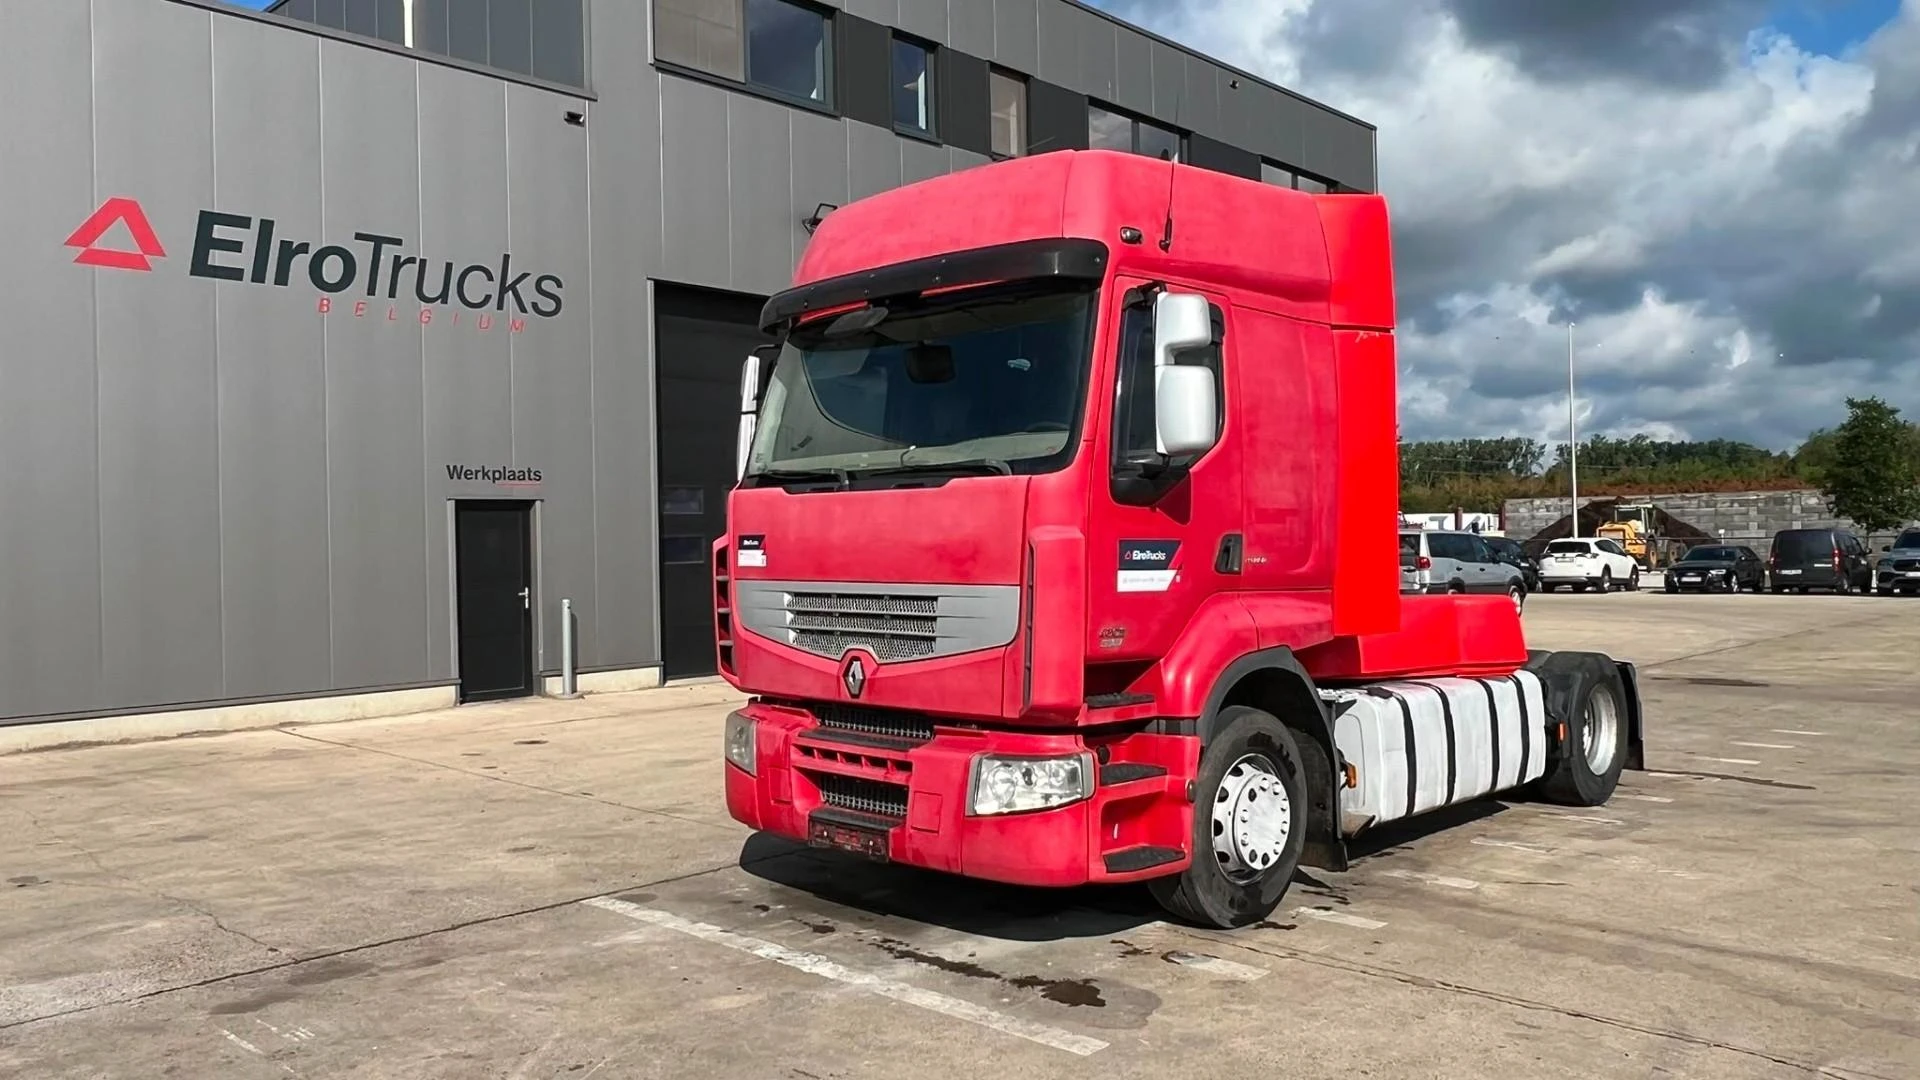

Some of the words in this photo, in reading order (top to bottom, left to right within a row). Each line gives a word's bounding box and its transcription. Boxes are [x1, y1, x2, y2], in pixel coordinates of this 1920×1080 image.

[189, 209, 564, 318] ElroTrucks
[318, 297, 526, 334] BELGIUM
[446, 464, 542, 484] Werkplaats
[1132, 550, 1166, 561] ElroTrucks
